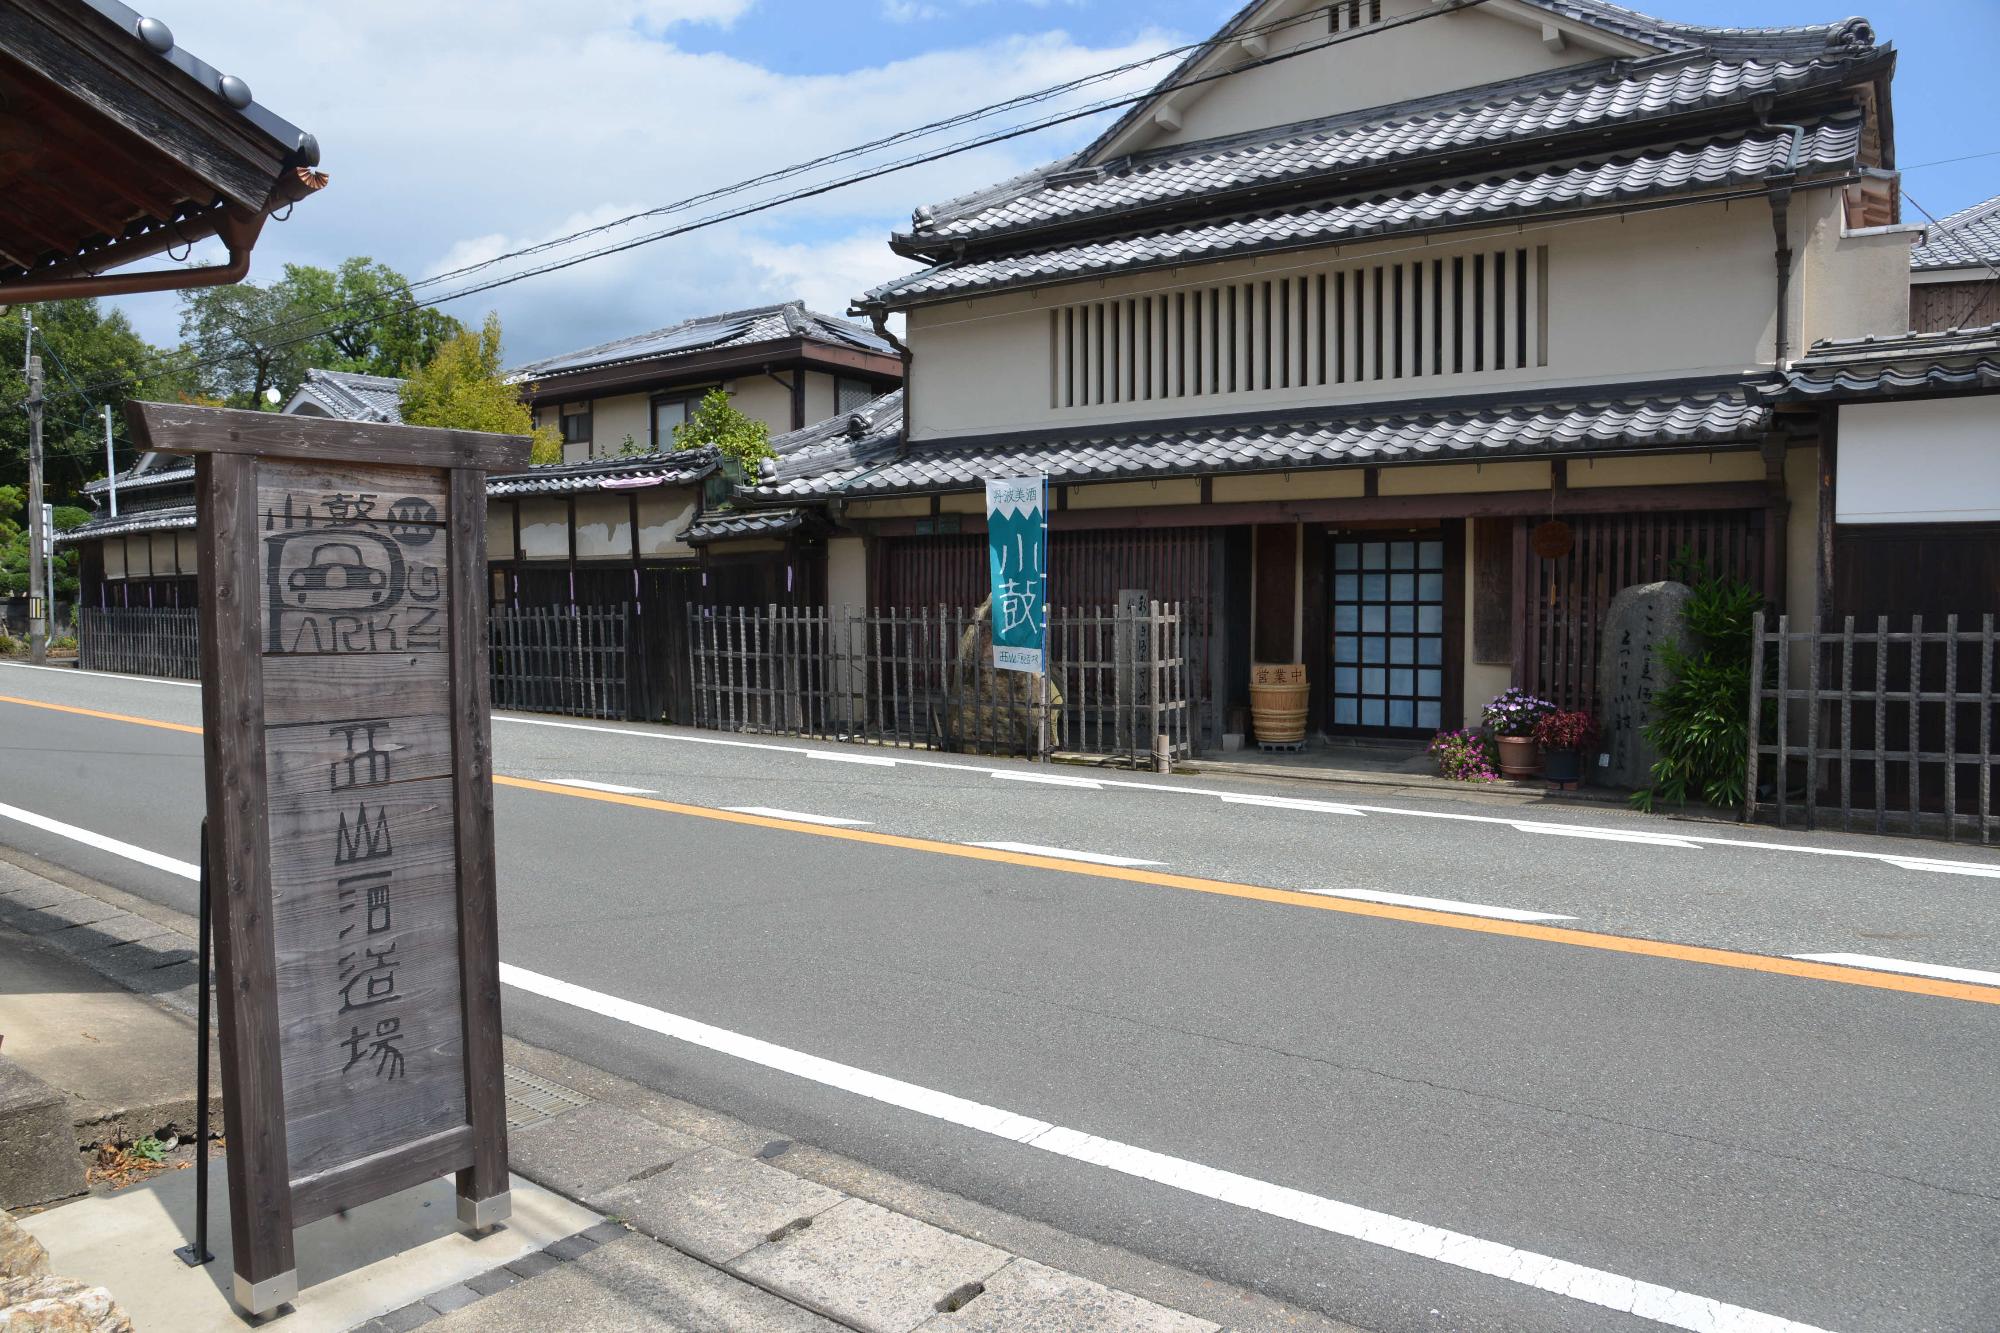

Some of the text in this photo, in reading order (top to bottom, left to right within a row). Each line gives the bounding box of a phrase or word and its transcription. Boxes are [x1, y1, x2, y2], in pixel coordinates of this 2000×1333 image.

[994, 488, 1037, 504] 丹波美酒
[998, 533, 1038, 634] 小鼓
[1256, 668, 1302, 684] 営業中
